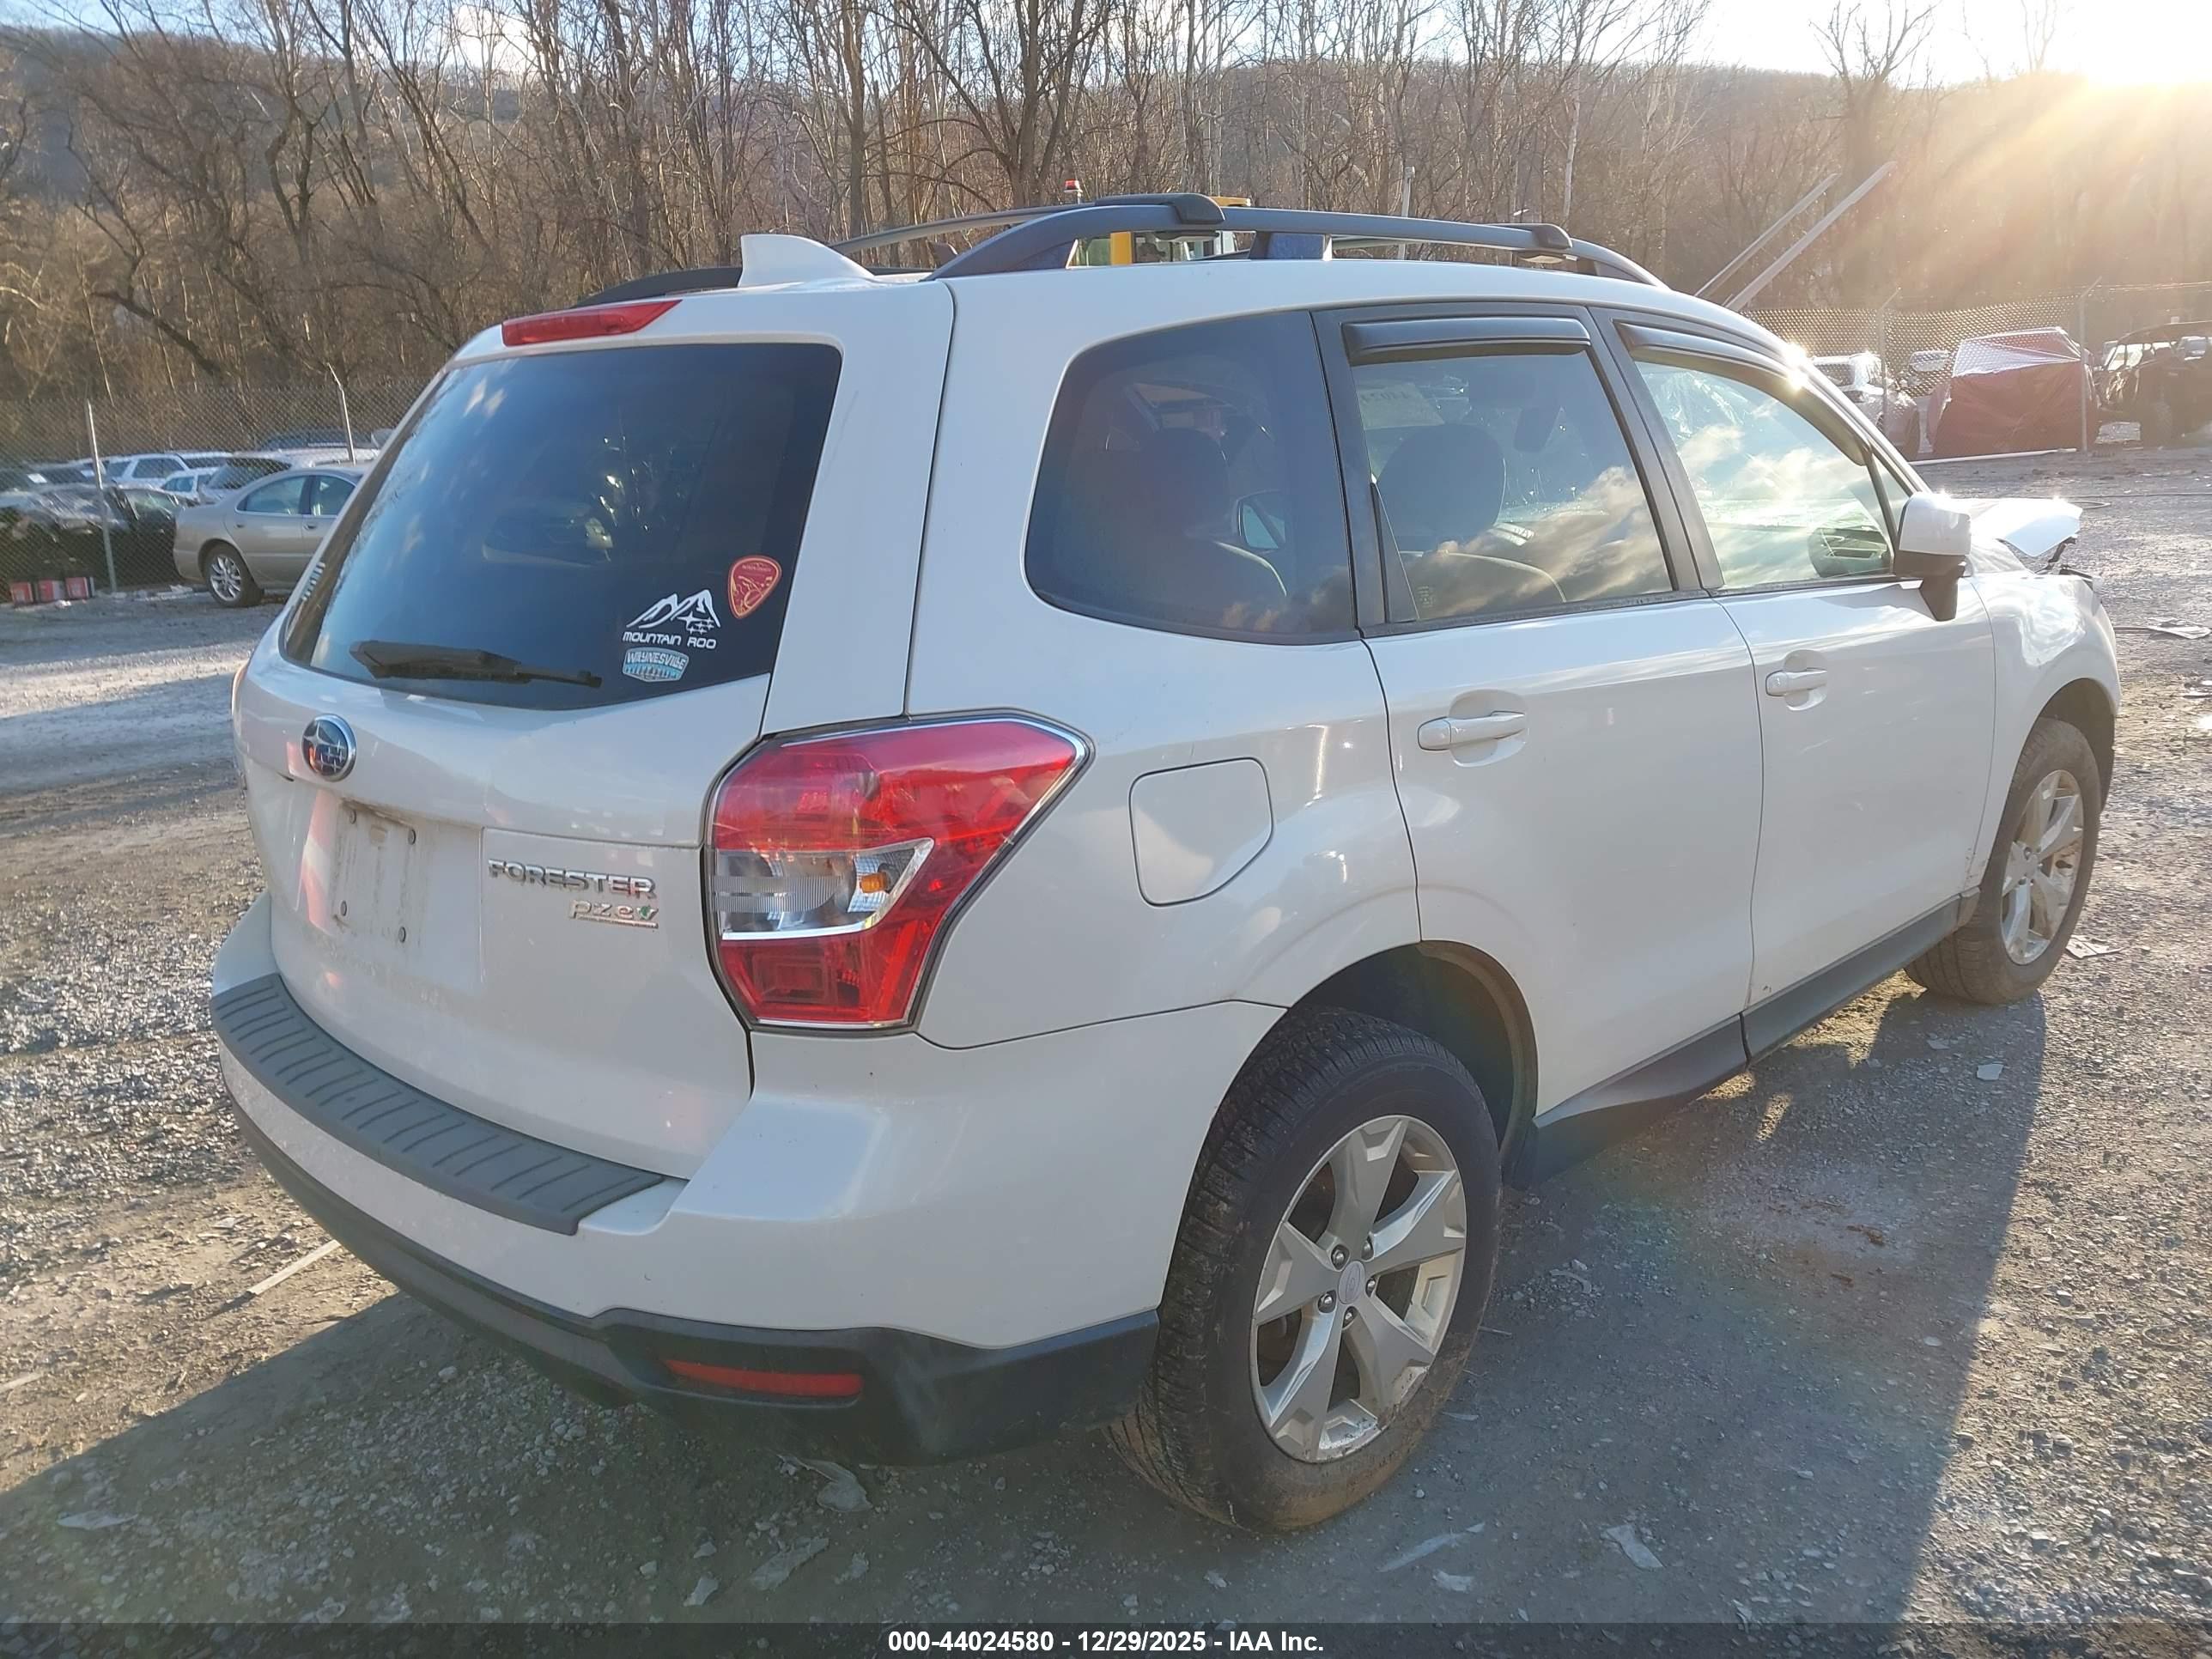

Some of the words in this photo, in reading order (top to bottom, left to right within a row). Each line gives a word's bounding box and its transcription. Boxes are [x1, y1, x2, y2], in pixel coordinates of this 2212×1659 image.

[623, 631, 682, 646] MOUNTAIN
[687, 636, 717, 649] ROO
[488, 858, 658, 899] FORESTER
